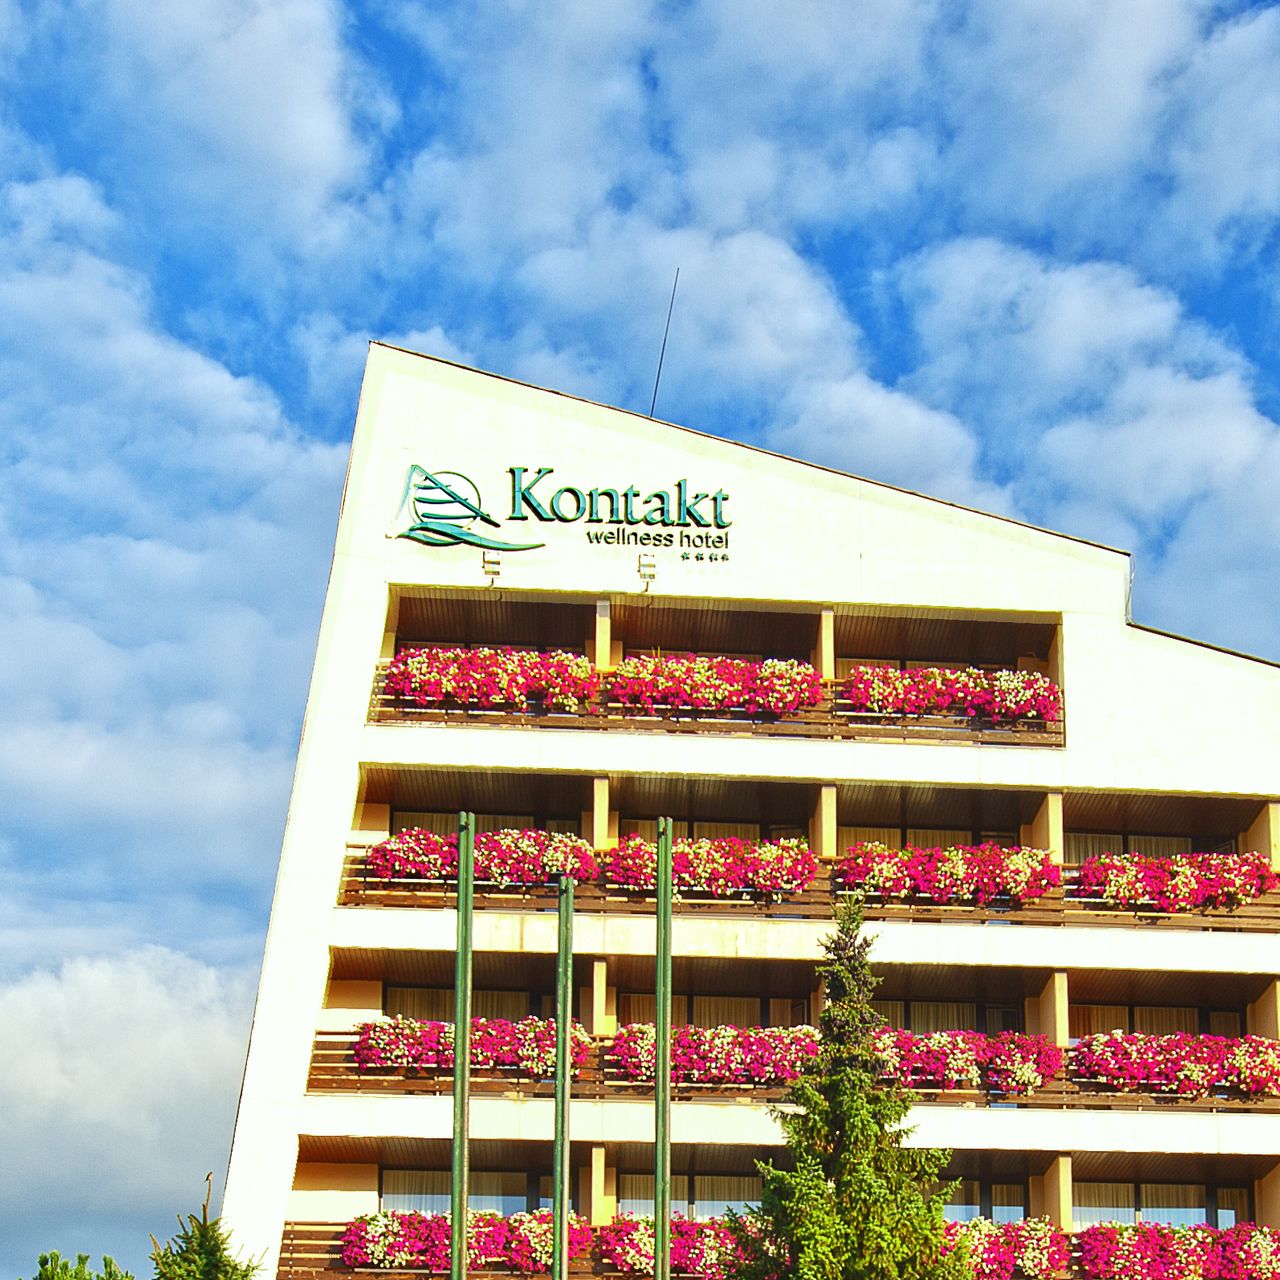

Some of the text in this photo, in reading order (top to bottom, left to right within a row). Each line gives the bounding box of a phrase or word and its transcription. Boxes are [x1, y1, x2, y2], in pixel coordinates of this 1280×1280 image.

[506, 467, 732, 529] Kontakt
[586, 528, 730, 550] wellness hotel
